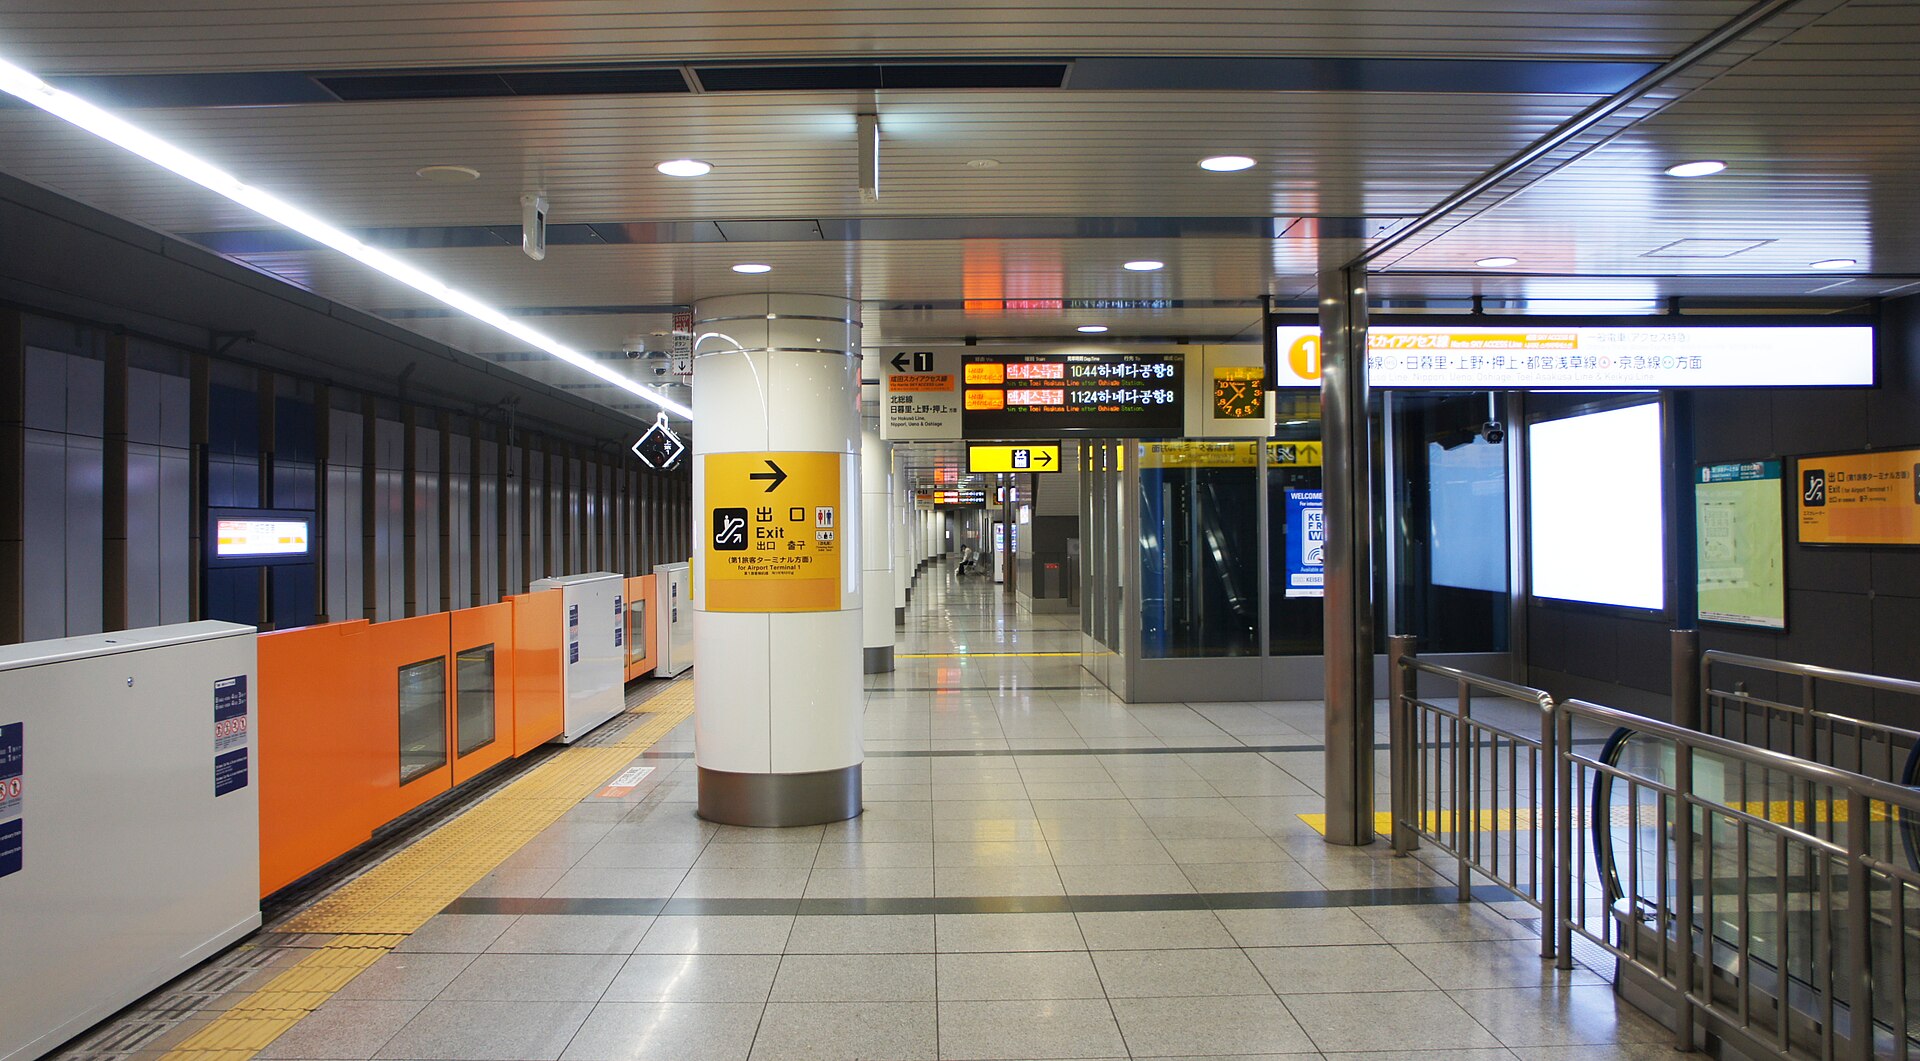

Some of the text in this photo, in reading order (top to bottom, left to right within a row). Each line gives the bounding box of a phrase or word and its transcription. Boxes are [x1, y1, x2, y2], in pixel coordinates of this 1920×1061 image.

[919, 353, 926, 371] 1
[1302, 340, 1316, 373] 1
[1071, 365, 1097, 378] 10:44
[1097, 363, 1166, 378] 하네다공항
[1071, 390, 1097, 403] 11:24
[1097, 389, 1166, 404] 하네다공항
[756, 527, 784, 539] Exit
[756, 541, 776, 550] 出口
